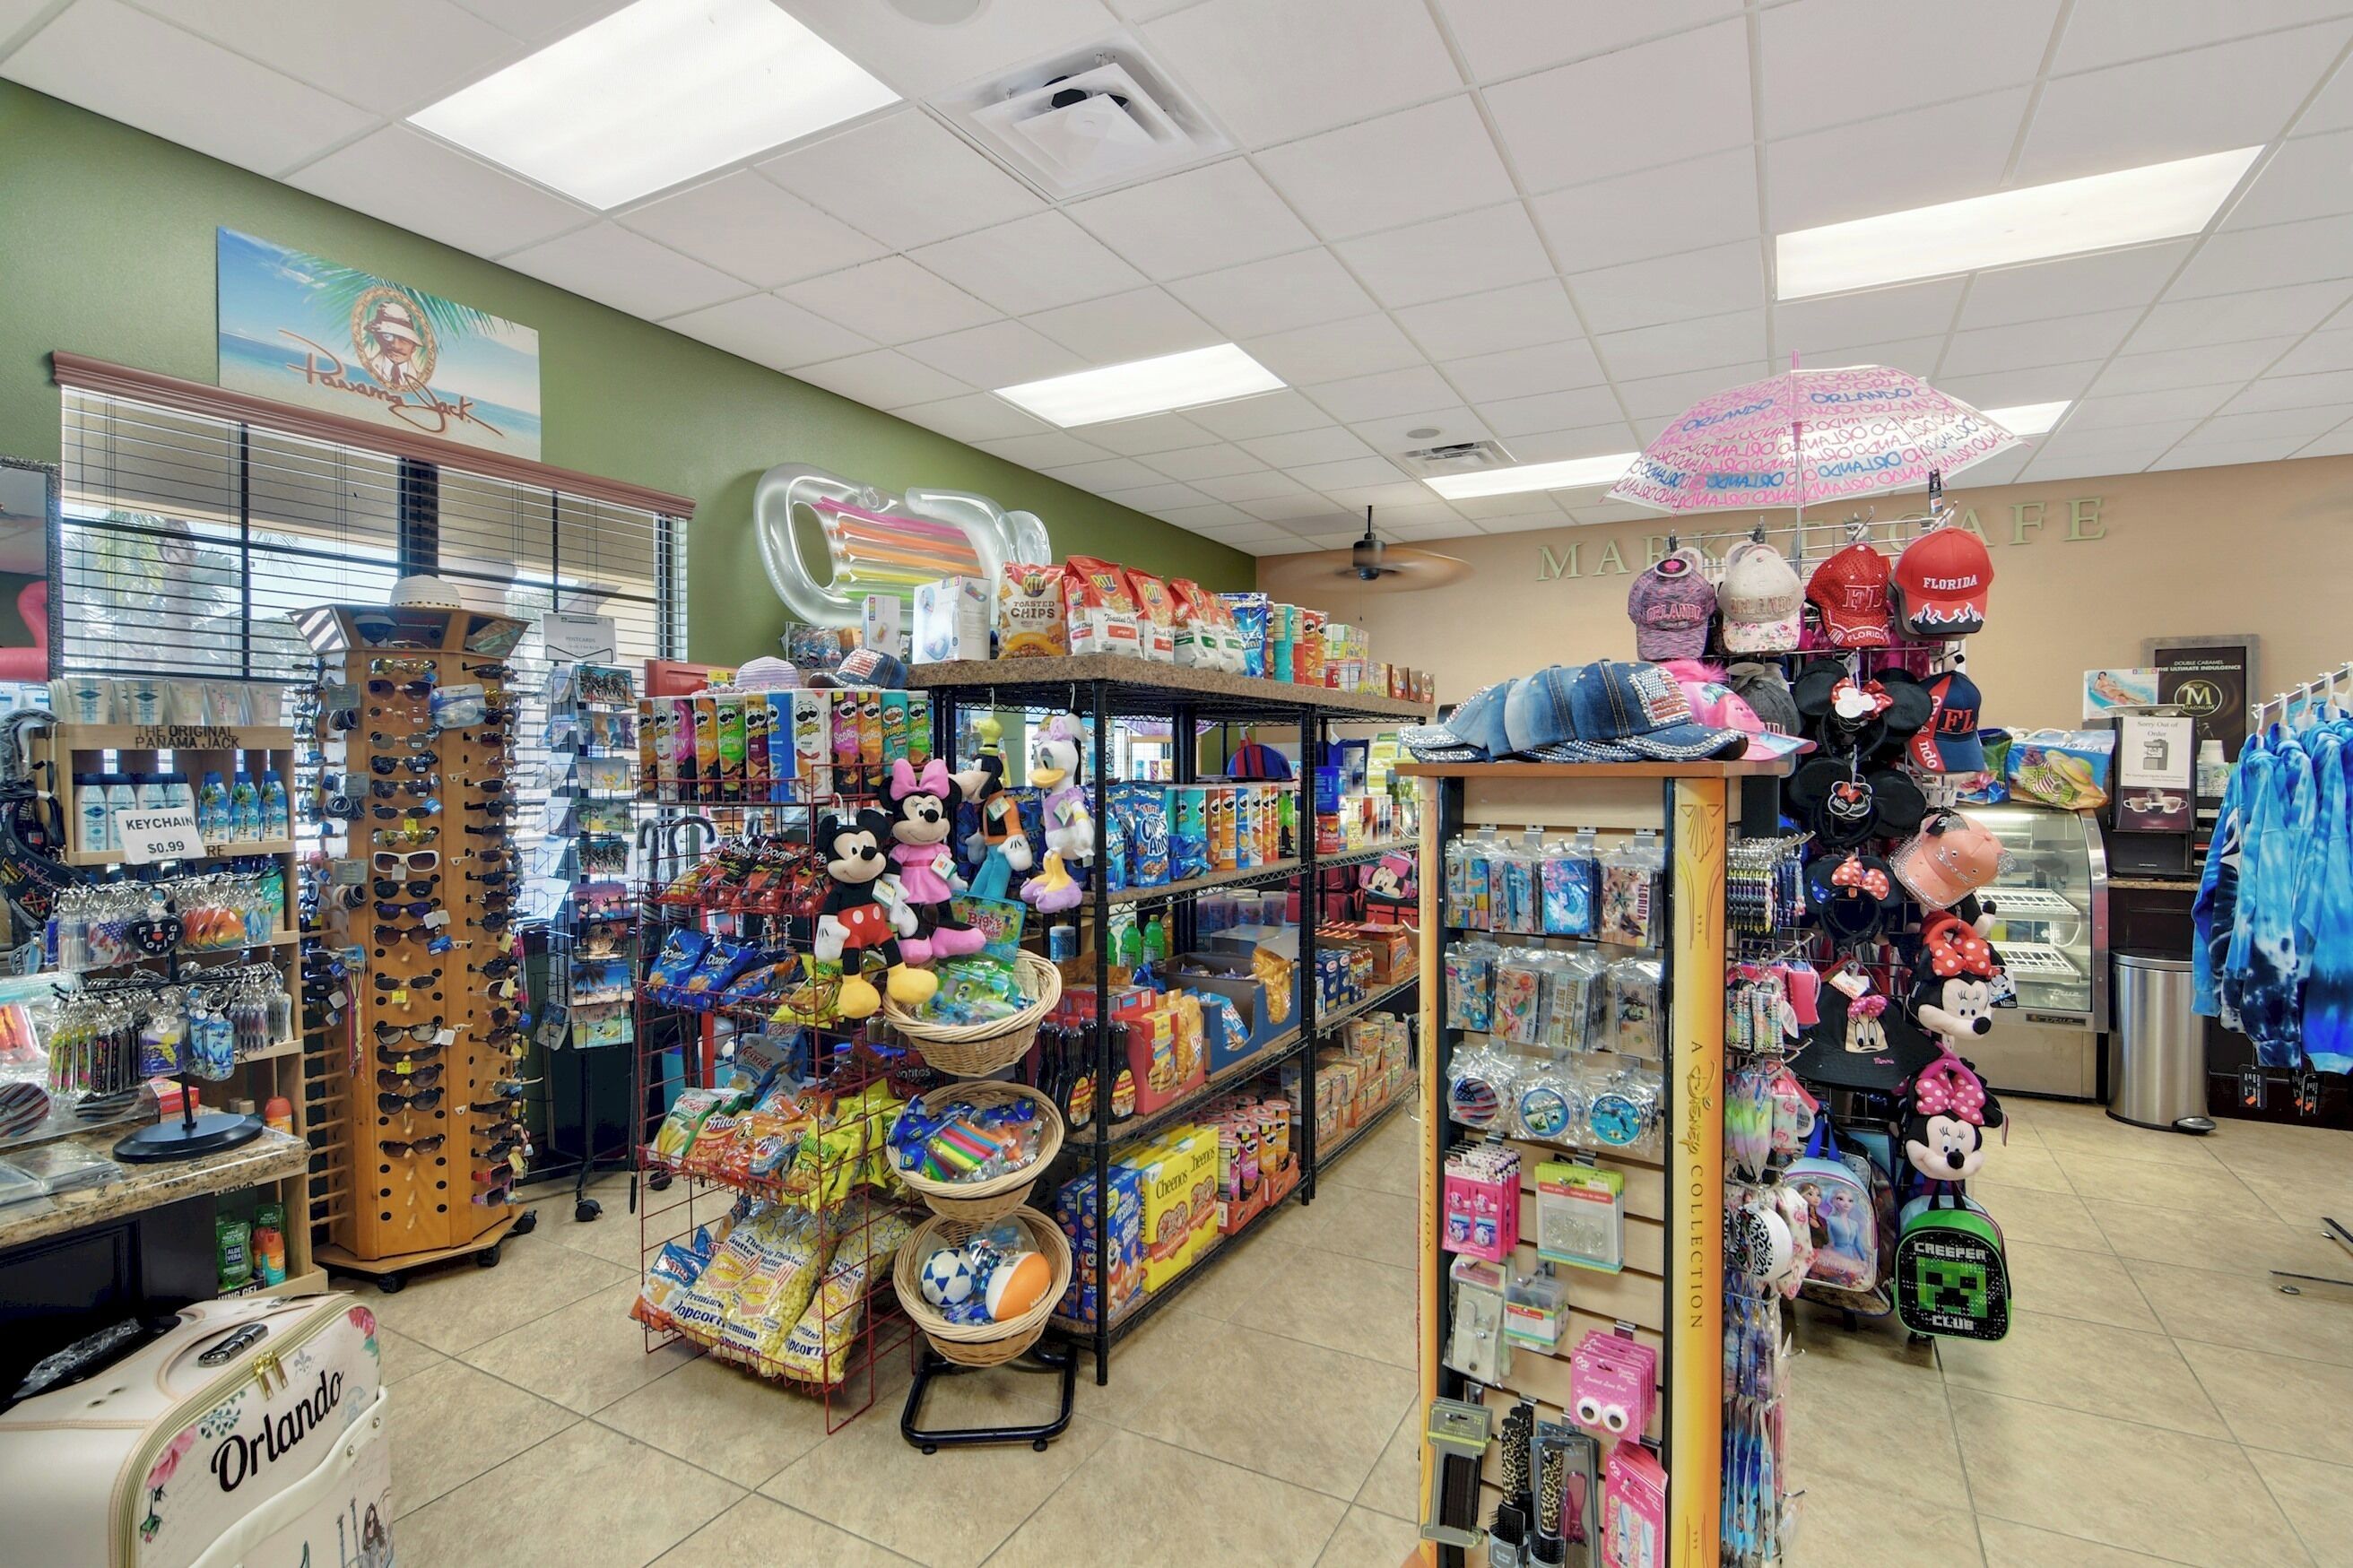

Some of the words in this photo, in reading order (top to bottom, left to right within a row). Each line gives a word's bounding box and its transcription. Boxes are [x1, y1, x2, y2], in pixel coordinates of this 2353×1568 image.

[278, 328, 404, 412] Panama
[391, 375, 505, 437] Jack
[1811, 387, 1912, 403] ORLANDO
[1682, 398, 1775, 432] ORLANDO
[1536, 520, 1824, 582] MARKT
[1887, 497, 2107, 553] CAFE
[1023, 575, 1046, 593] RITZ
[1090, 574, 1118, 590] RITZ
[1922, 574, 1978, 591] FLORIDA
[1143, 584, 1163, 601] RITZ
[1842, 585, 1883, 611] FL
[1011, 608, 1055, 619] CHIPS
[1646, 603, 1702, 625] ORLANDO
[1729, 594, 1794, 616] ORLANDO
[1847, 630, 1886, 643] FLORIDA
[2183, 685, 2213, 706] M
[1940, 708, 1975, 733] FL
[2137, 721, 2155, 729] Sorry
[2171, 720, 2179, 728] of
[135, 725, 165, 738] THE
[168, 724, 237, 738] ORIGINAL
[795, 723, 821, 741] Pringles
[135, 737, 197, 749] PANAMA
[203, 737, 240, 749] JACK
[126, 815, 195, 831] KEYCHAIN
[147, 840, 186, 854] $0.99
[1637, 883, 1649, 921] FLORIDA
[1691, 1040, 1704, 1053] A
[897, 1067, 932, 1079] oritos
[705, 1114, 739, 1132] Fritos
[1156, 1169, 1189, 1200] Cheerios
[227, 1246, 241, 1254] ALOE
[728, 1235, 756, 1257] Butter
[1689, 1164, 1705, 1329] COLLECTION
[1914, 1241, 1988, 1261] CREEPER
[227, 1253, 242, 1262] VERA
[760, 1255, 783, 1269] Butter
[685, 1290, 725, 1310] Premium
[727, 1321, 759, 1341] emium
[1932, 1314, 1975, 1332] CLUB
[210, 1367, 344, 1493] Orlando
